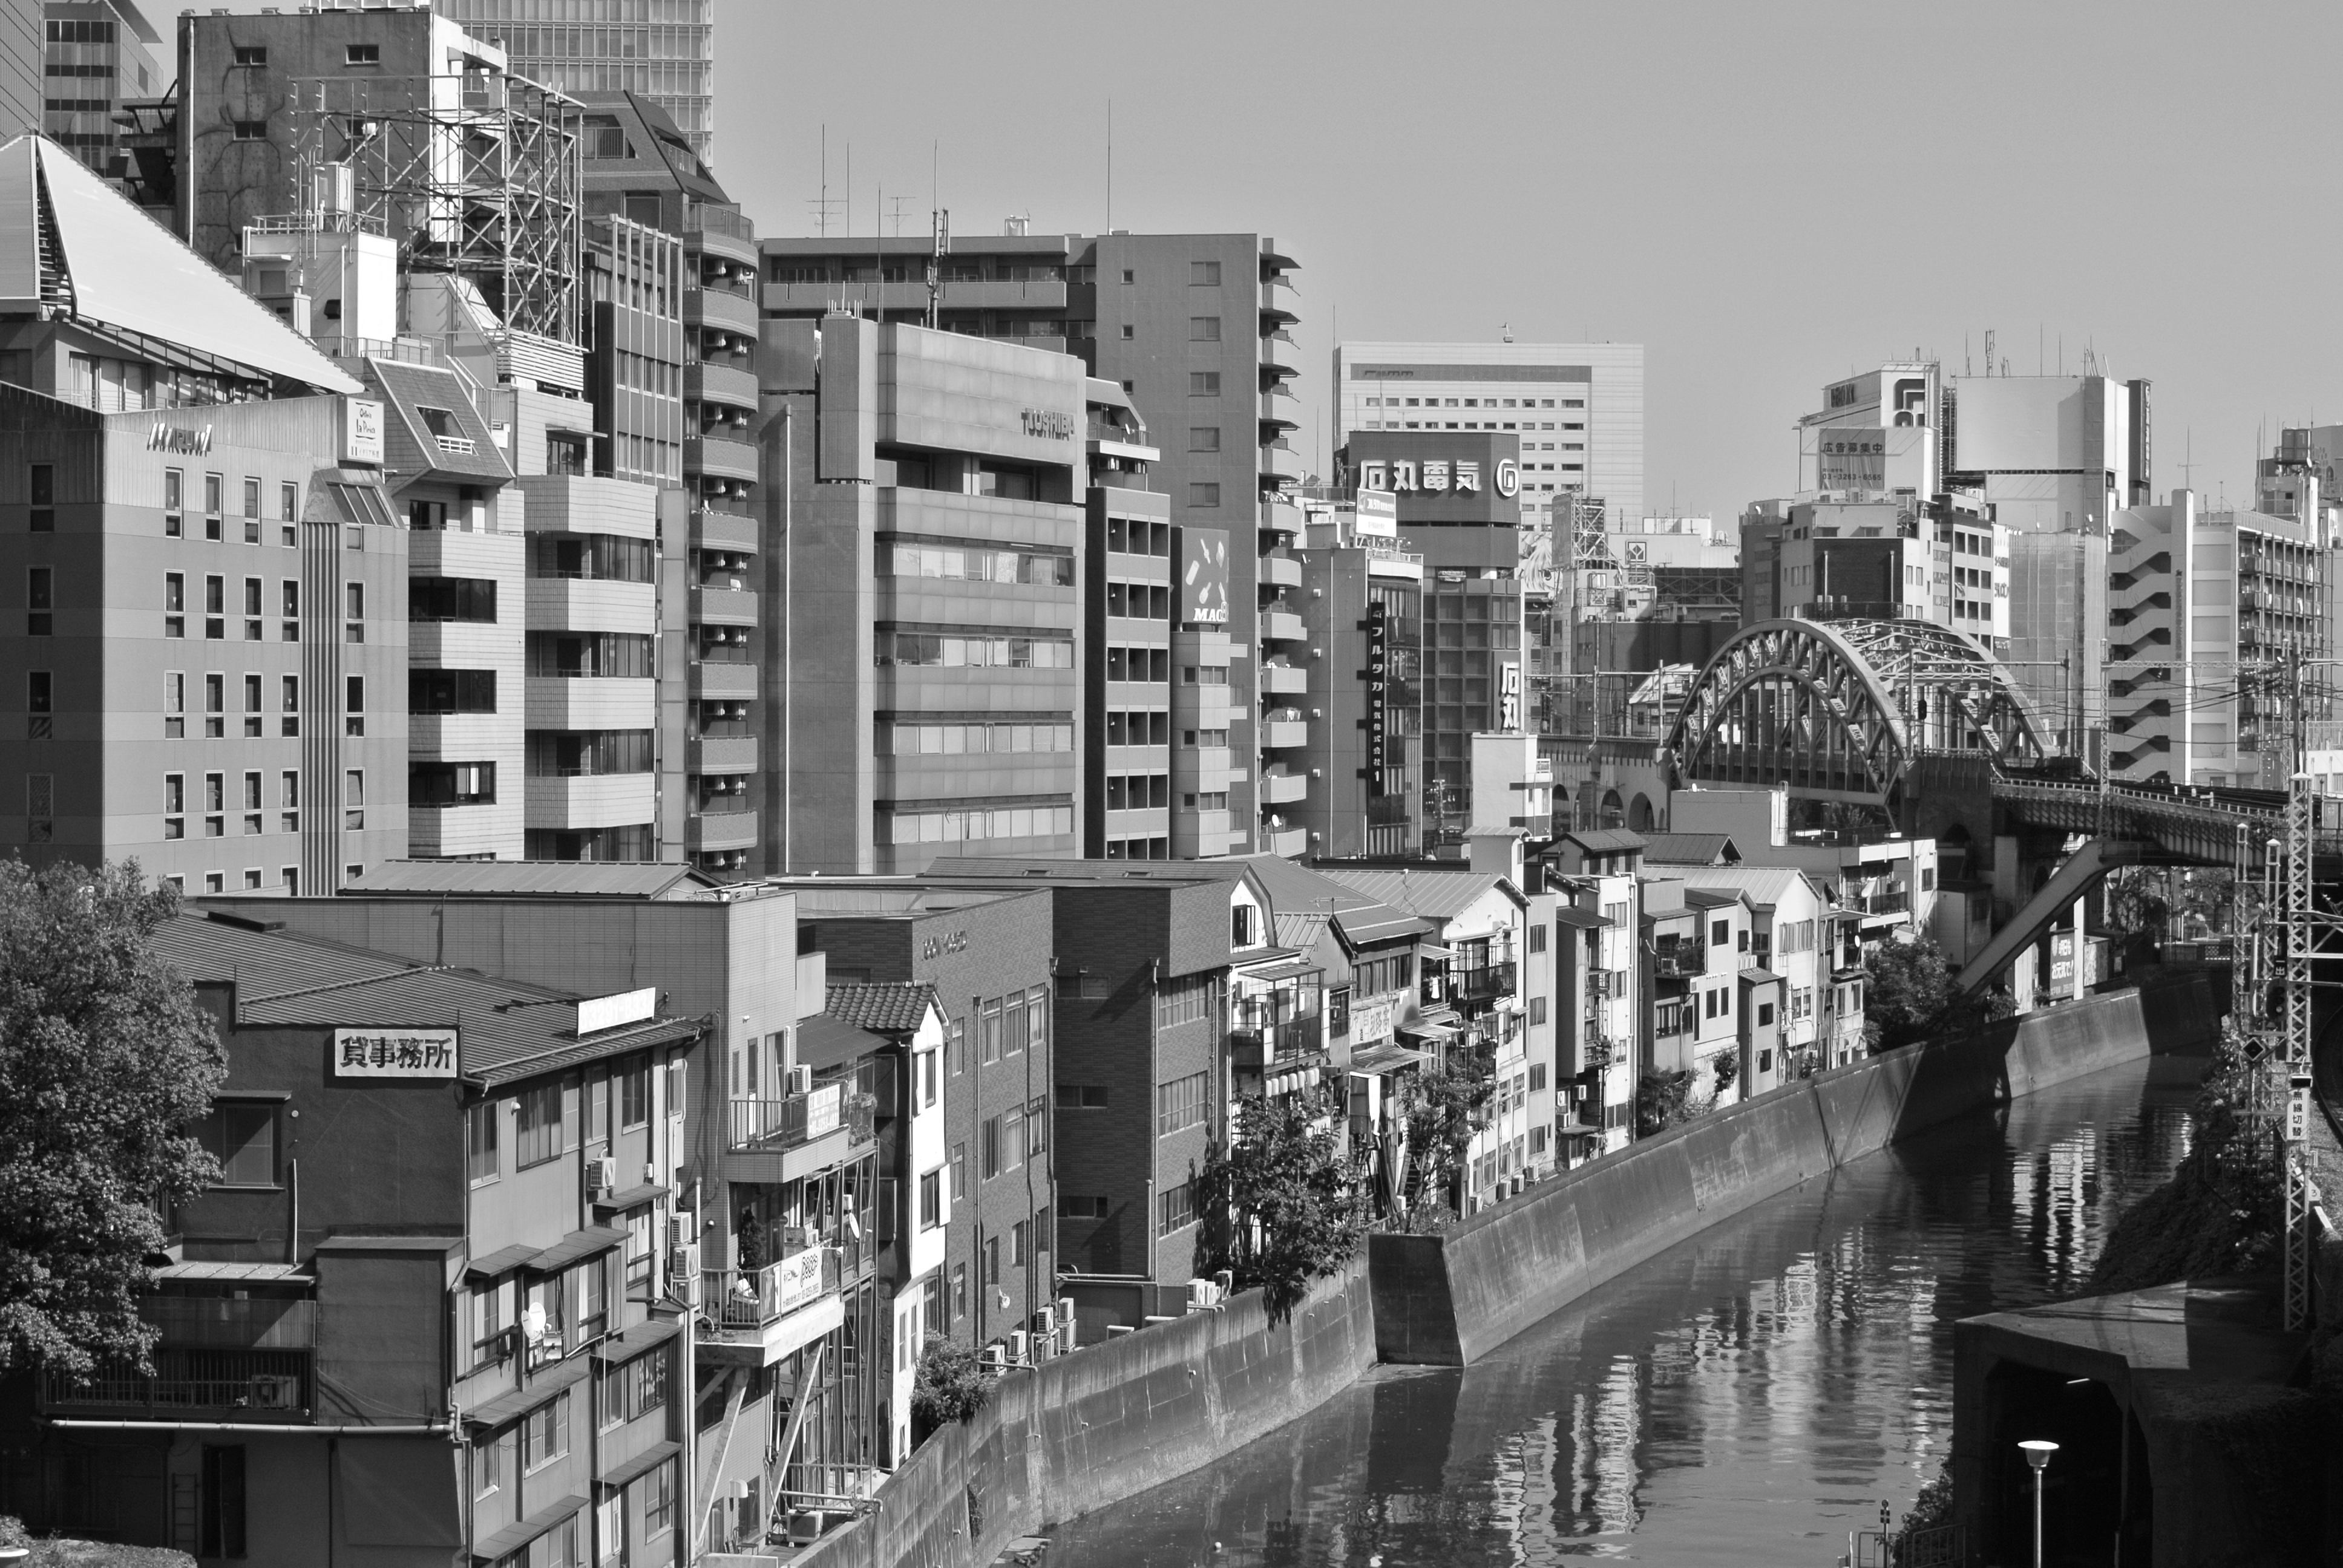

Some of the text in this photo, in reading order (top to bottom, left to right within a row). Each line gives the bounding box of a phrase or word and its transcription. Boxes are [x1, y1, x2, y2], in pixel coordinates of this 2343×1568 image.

[1024, 408, 1075, 436] TOSHIBA
[1823, 442, 1883, 454] 広告募集中
[1359, 459, 1483, 491] 石丸電気
[1501, 661, 1519, 728] 石丸
[340, 1036, 453, 1069] 貸事務所
[2292, 1091, 2302, 1136] 無線切替
